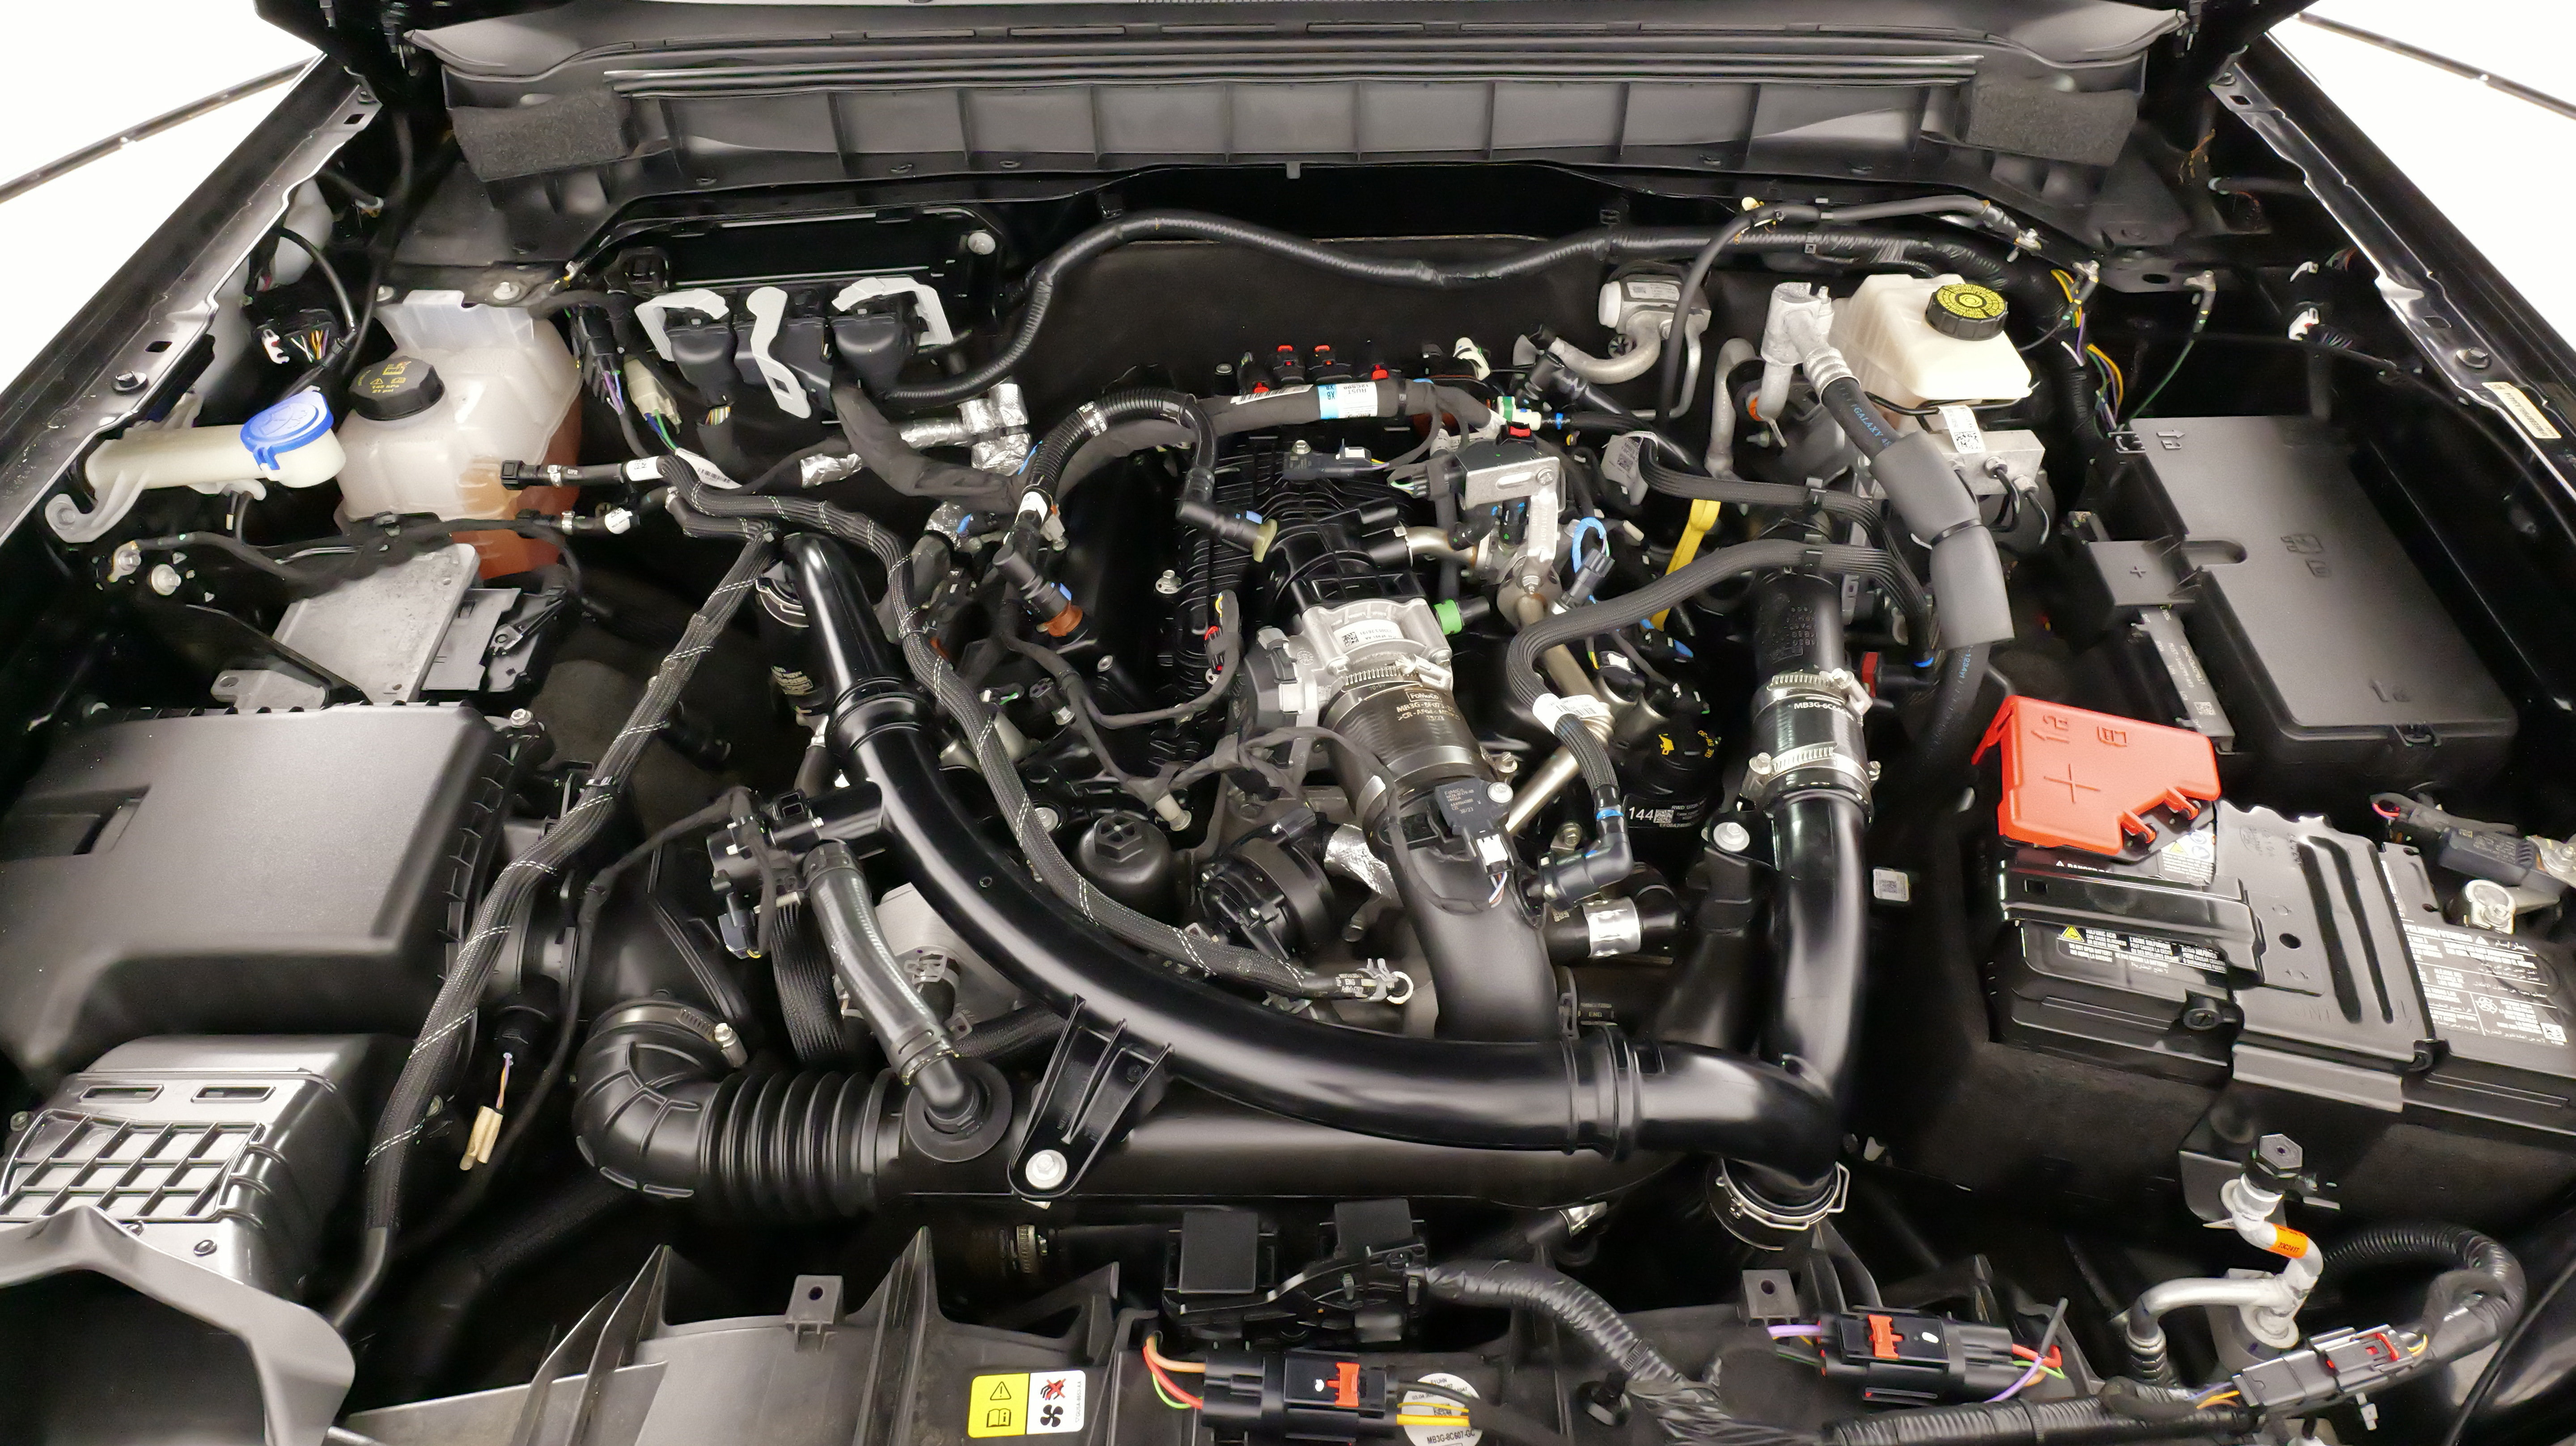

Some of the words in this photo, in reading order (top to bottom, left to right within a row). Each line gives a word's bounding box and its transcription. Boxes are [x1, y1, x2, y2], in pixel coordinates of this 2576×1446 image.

[1327, 391, 1335, 399] XB
[1854, 407, 1883, 437] GALAXY
[1704, 749, 1715, 759] SAE
[1629, 806, 1654, 821] 144
[1427, 1429, 1475, 1444] MB3G-8C607-GC
